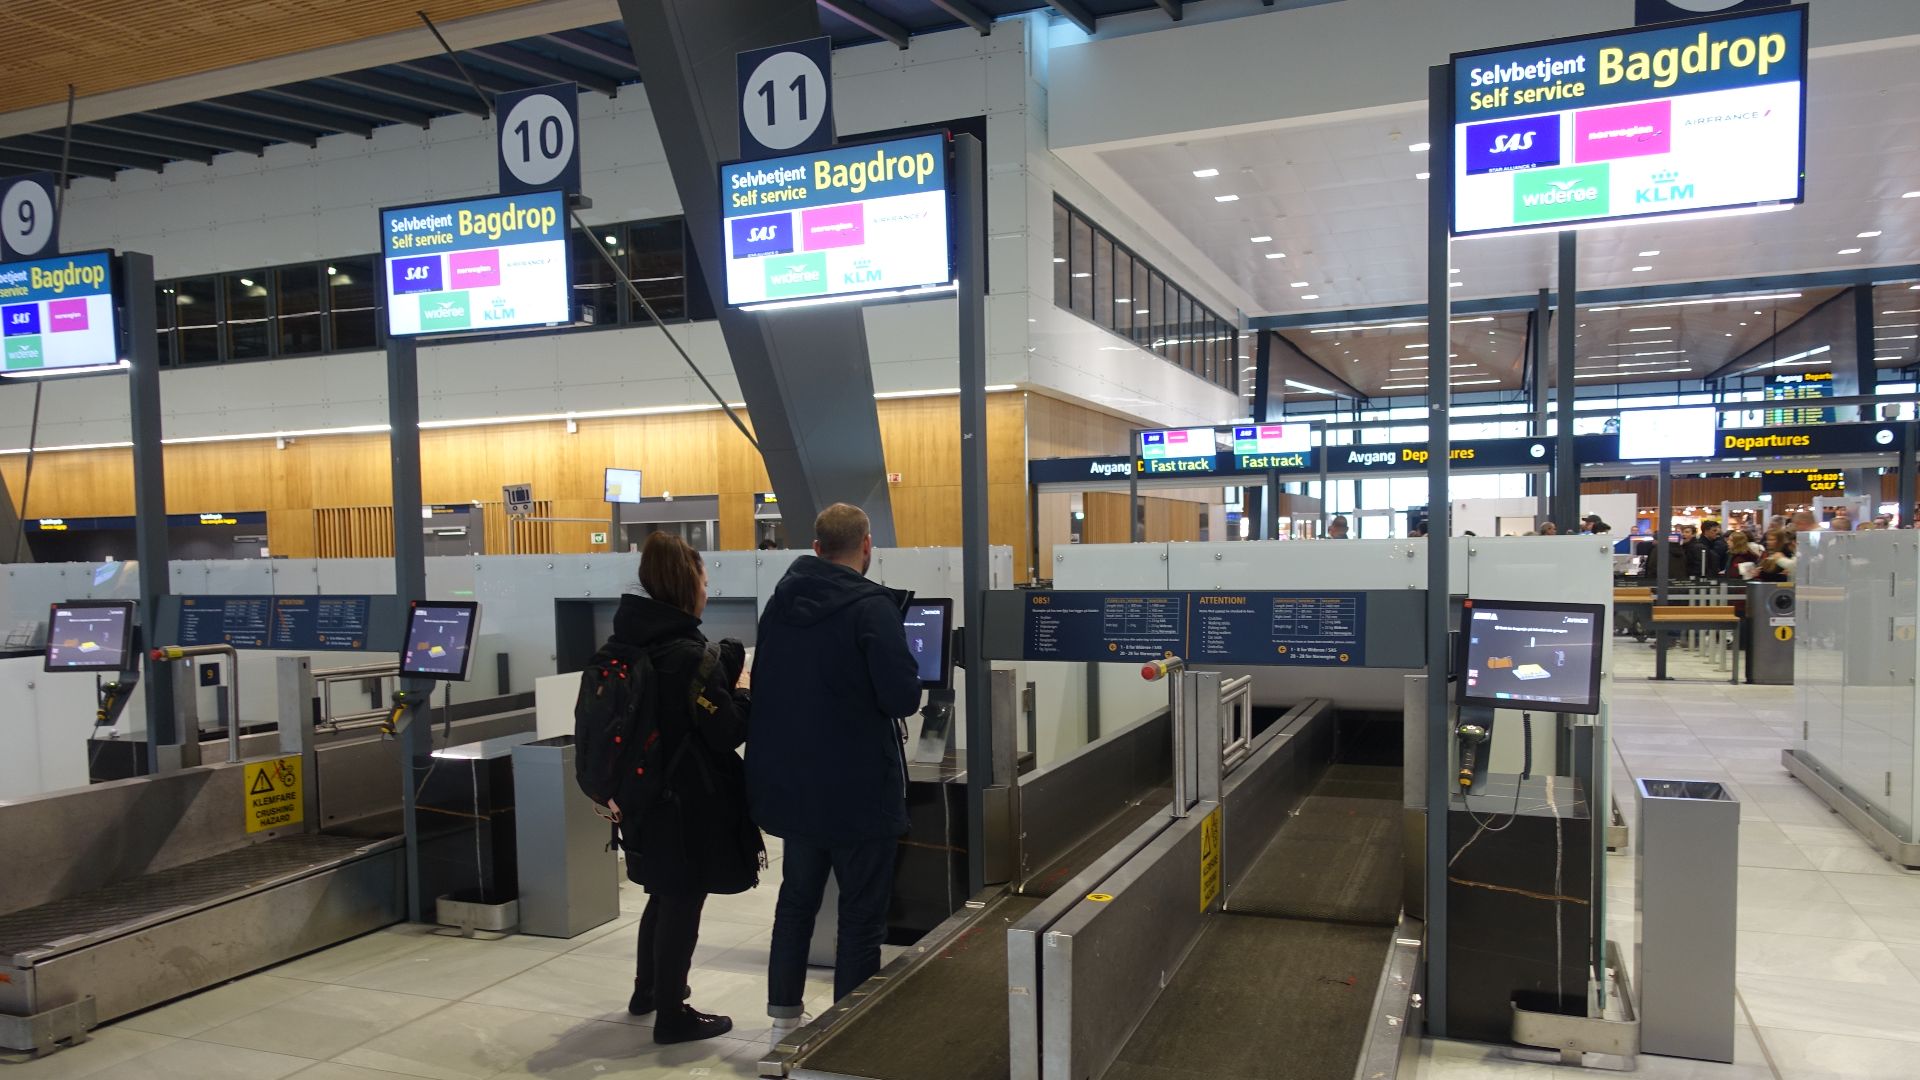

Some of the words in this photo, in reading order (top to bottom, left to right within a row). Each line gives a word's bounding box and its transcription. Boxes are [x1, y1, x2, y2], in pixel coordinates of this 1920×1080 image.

[1598, 32, 1786, 88] Bagdrop
[1470, 55, 1586, 87] Selvbetjent
[757, 74, 807, 126] 11
[1470, 87, 1509, 110] Self
[1513, 80, 1585, 105] service
[514, 115, 563, 163] 10
[1489, 131, 1537, 154] SAS
[1588, 124, 1654, 142] norwegian
[731, 165, 806, 189] Selvbetjent
[814, 150, 934, 193] Bagdrop
[732, 190, 758, 208] Self
[760, 186, 807, 203] service
[1635, 183, 1694, 204] KLM
[18, 200, 35, 236] 9
[391, 213, 453, 233] Selvbetjent
[458, 202, 556, 240] Bagdrop
[392, 233, 413, 250] Self
[415, 231, 453, 246] service
[747, 225, 777, 243] SAS
[31, 261, 105, 294] Bagdrop
[405, 265, 430, 280] SAS
[844, 270, 882, 285] KLM
[484, 308, 516, 321] KLM
[1725, 434, 1810, 451] Departures
[1151, 459, 1176, 473] Fast
[1178, 458, 1209, 471] track
[1242, 455, 1268, 468] Fast
[1270, 453, 1304, 467] track
[1348, 450, 1396, 466] Avgang
[1402, 448, 1475, 464] Depures
[1090, 461, 1131, 476] Avgang
[1032, 596, 1051, 605] OBS!
[1199, 596, 1246, 605] ATTENTION!
[253, 791, 297, 808] KLEMFARE
[255, 803, 295, 818] CRUSHING
